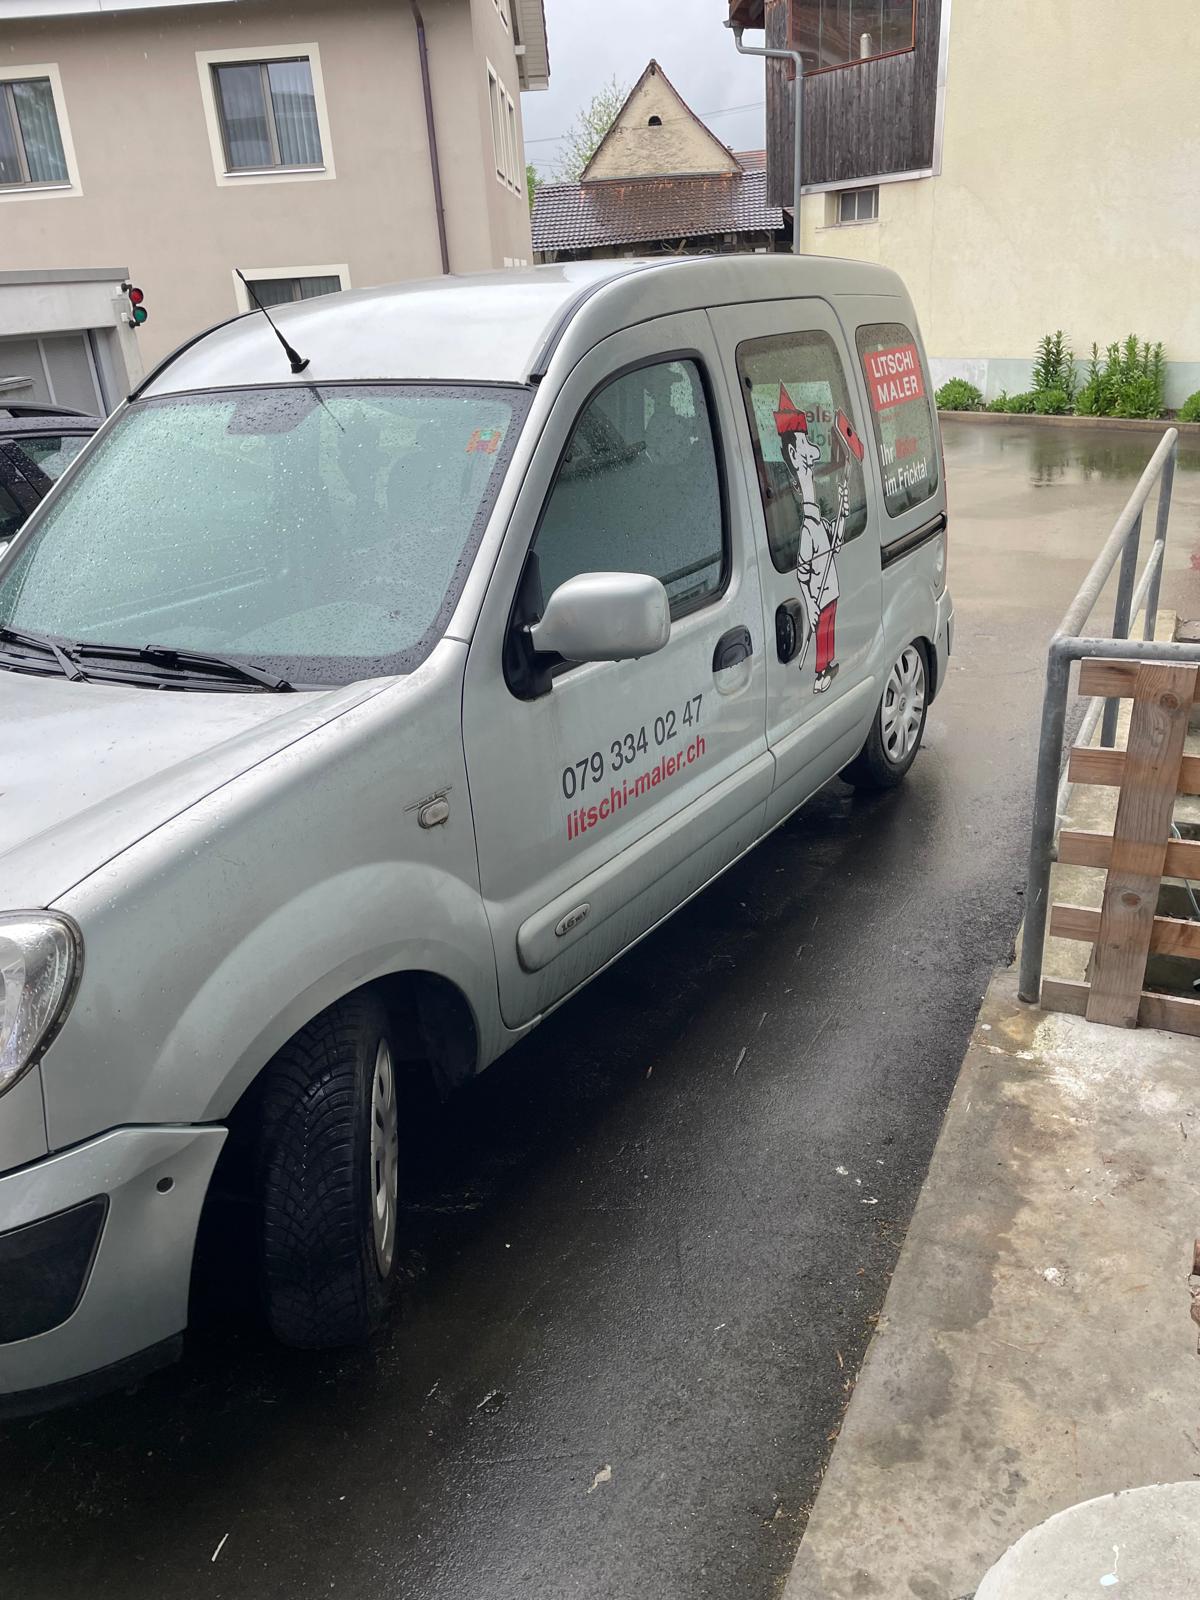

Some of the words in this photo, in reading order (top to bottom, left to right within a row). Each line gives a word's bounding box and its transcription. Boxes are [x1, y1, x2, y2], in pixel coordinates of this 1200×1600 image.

[871, 350, 914, 378] LITSCHI
[877, 375, 919, 404] MALER
[880, 443, 894, 466] Ihr
[885, 475, 898, 497] im
[897, 457, 927, 490] Fricktal
[562, 752, 604, 799] 079
[610, 726, 648, 771] 334
[654, 710, 677, 746] 02
[682, 693, 702, 727] 47
[567, 734, 705, 840] litschi-maler.ch
